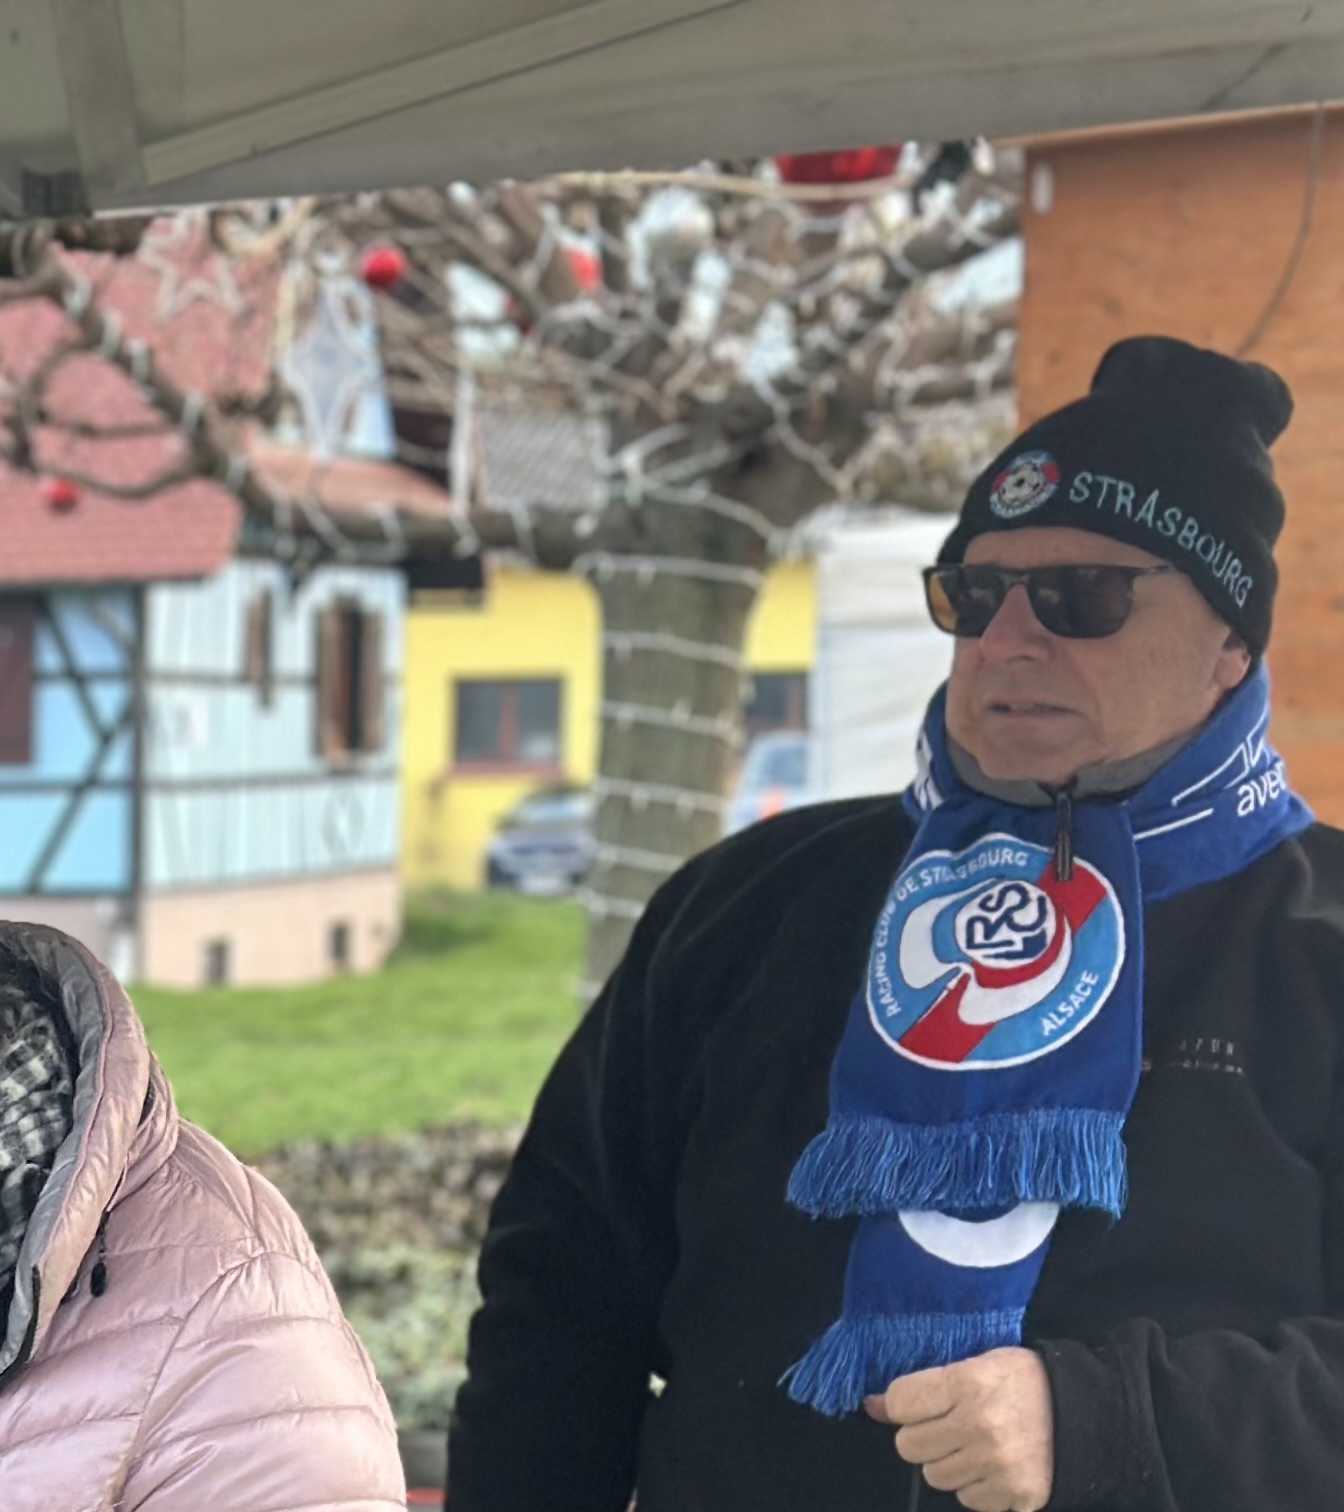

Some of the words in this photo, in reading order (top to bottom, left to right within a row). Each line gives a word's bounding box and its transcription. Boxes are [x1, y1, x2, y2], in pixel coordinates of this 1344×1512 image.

[1069, 471, 1253, 608] STRASBOURG
[896, 876, 919, 901] DE
[1041, 970, 1099, 1037] ALSACE
